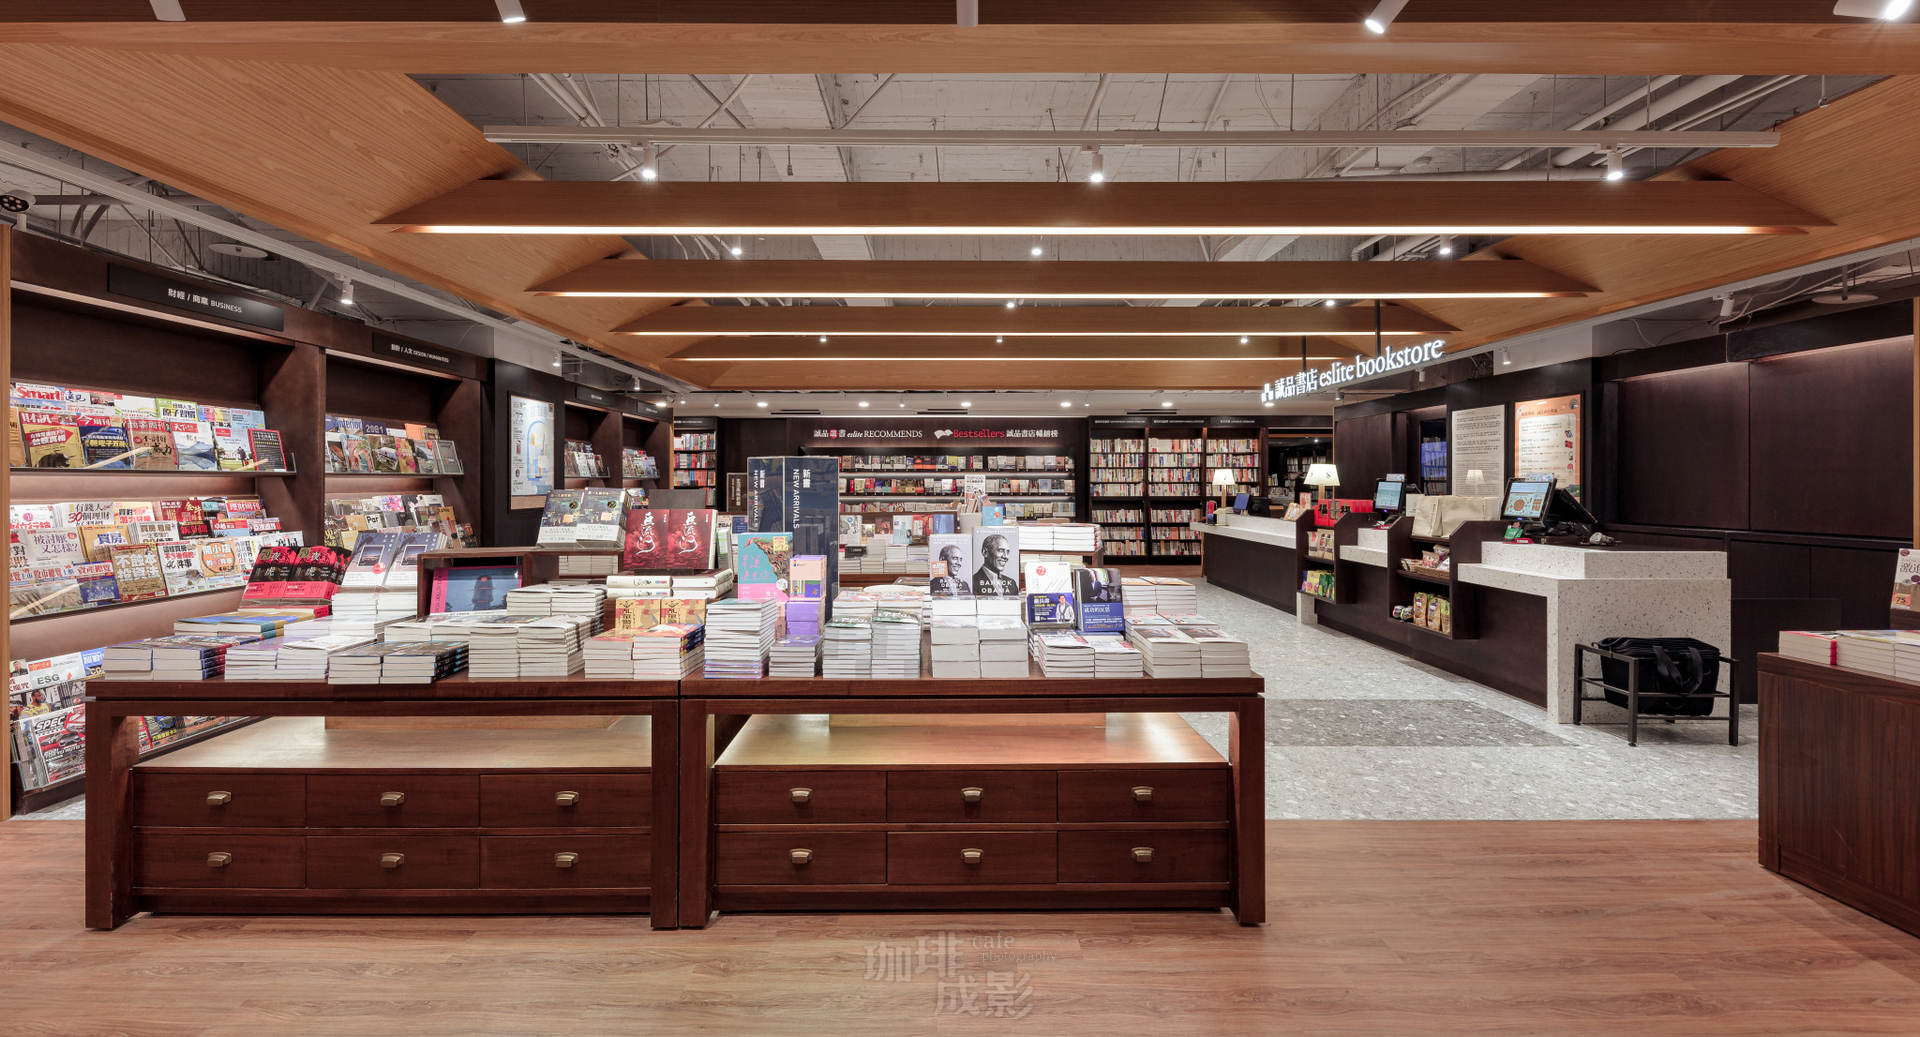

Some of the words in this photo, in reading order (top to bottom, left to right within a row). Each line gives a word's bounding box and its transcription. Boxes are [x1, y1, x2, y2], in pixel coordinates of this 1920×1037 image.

[168, 288, 185, 300] 財經
[192, 294, 208, 306] 商業
[210, 300, 242, 313] BUSINESS
[1274, 368, 1319, 399] 誠品書店
[1319, 361, 1355, 387] eslite
[1356, 339, 1446, 378] bookstore
[16, 386, 61, 401] Smart
[863, 430, 923, 438] RECOMMENDS
[953, 429, 1005, 438] Bestsellers
[803, 469, 811, 488] 新書
[37, 673, 60, 685] ESG
[35, 717, 65, 731] SPEC
